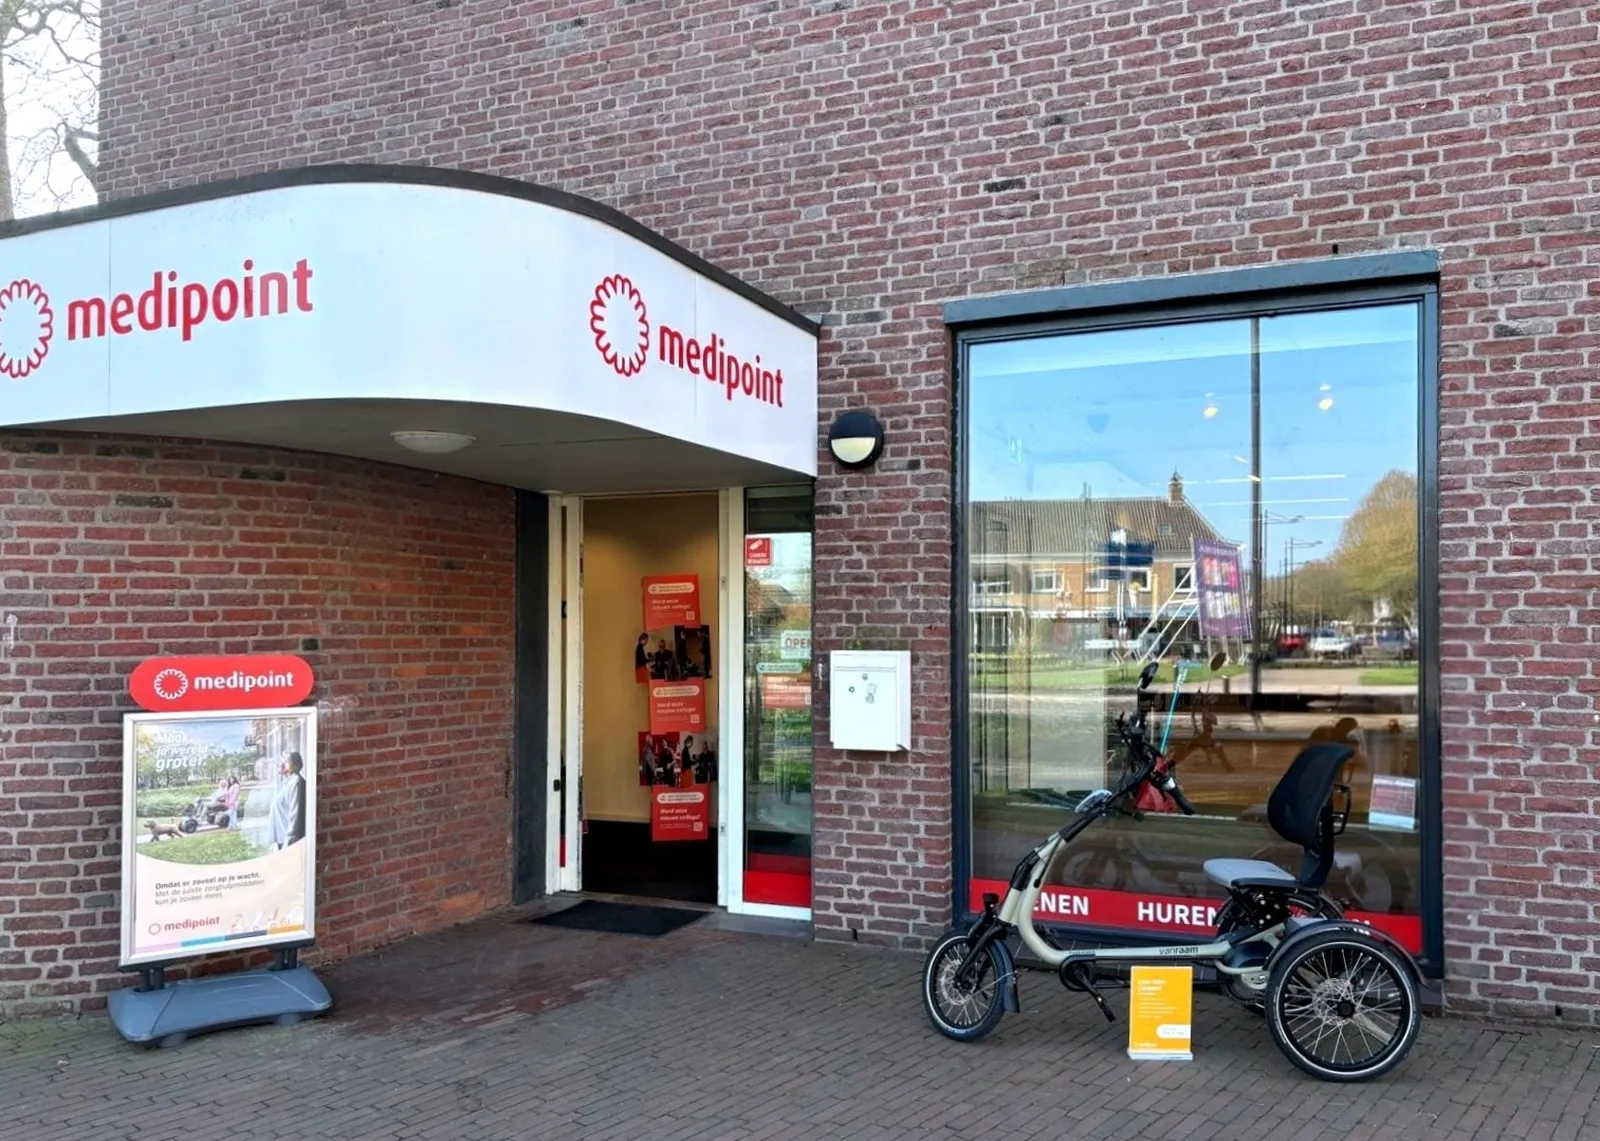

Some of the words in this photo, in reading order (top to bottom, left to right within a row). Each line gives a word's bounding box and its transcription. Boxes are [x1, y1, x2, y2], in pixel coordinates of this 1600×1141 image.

[67, 258, 314, 342] medipoint
[659, 325, 784, 408] medipoint
[194, 671, 294, 692] medipoint
[155, 756, 207, 772] groter.
[155, 881, 181, 890] Omdat
[192, 877, 217, 886] zoveel
[228, 874, 236, 883] je
[237, 872, 261, 880] wacht.
[155, 890, 170, 898] Met
[1033, 892, 1089, 916] NEN
[164, 916, 220, 931] medipoint
[1159, 946, 1199, 956] vanraam
